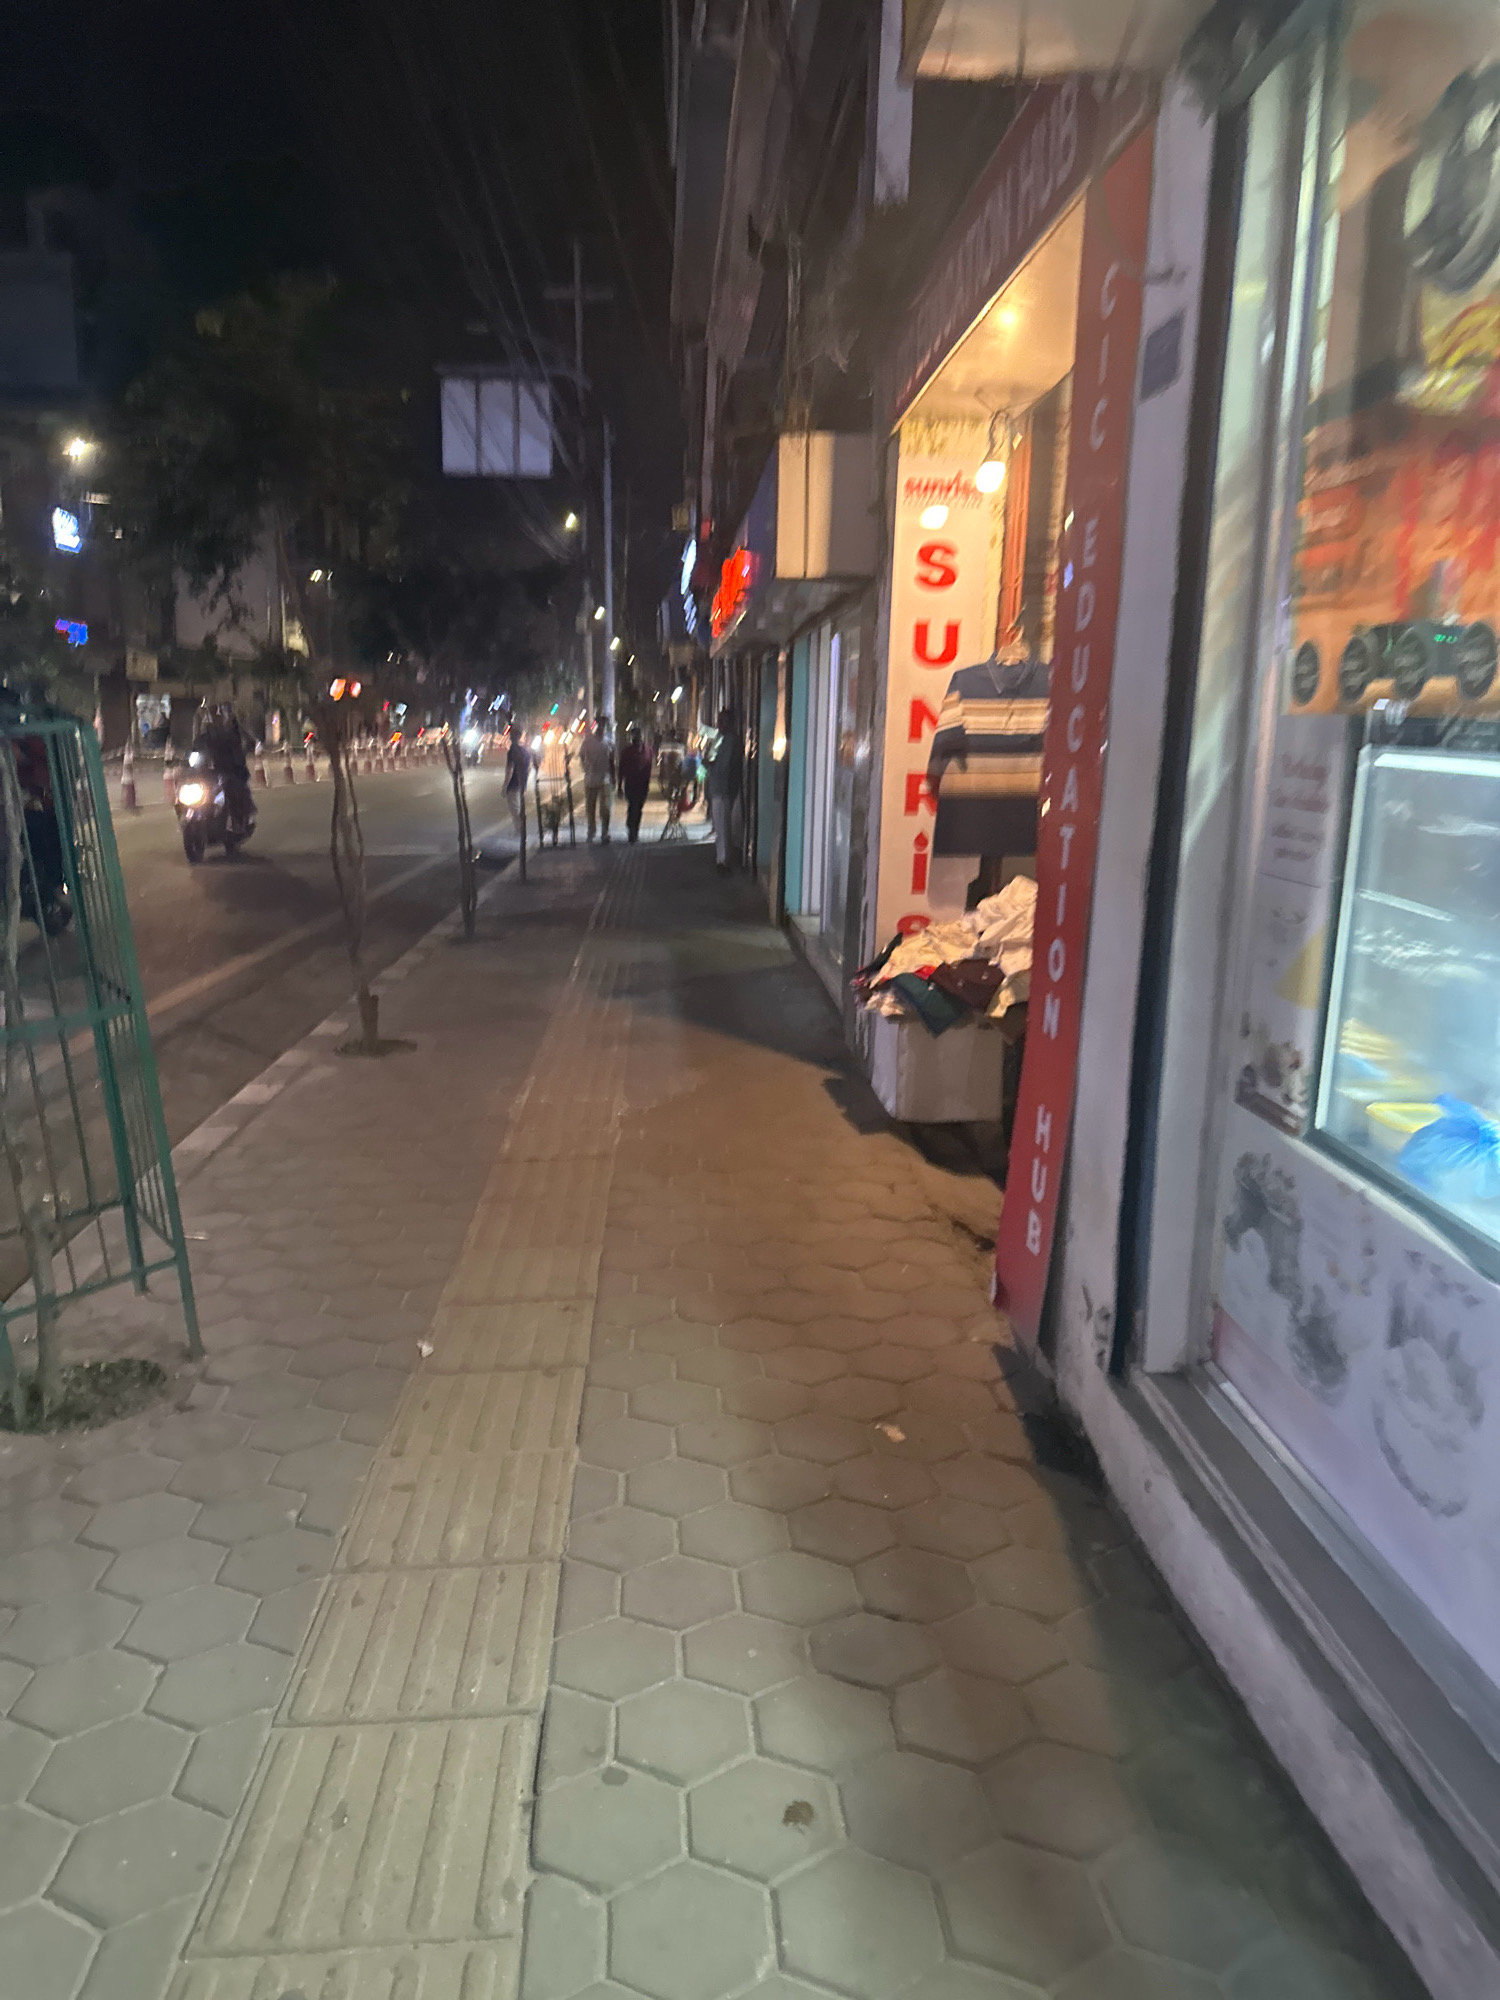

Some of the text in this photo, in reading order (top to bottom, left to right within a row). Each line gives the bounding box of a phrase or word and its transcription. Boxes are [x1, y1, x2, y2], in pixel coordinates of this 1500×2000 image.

[1026, 261, 1119, 1256] CIC EDUCATION HUB
